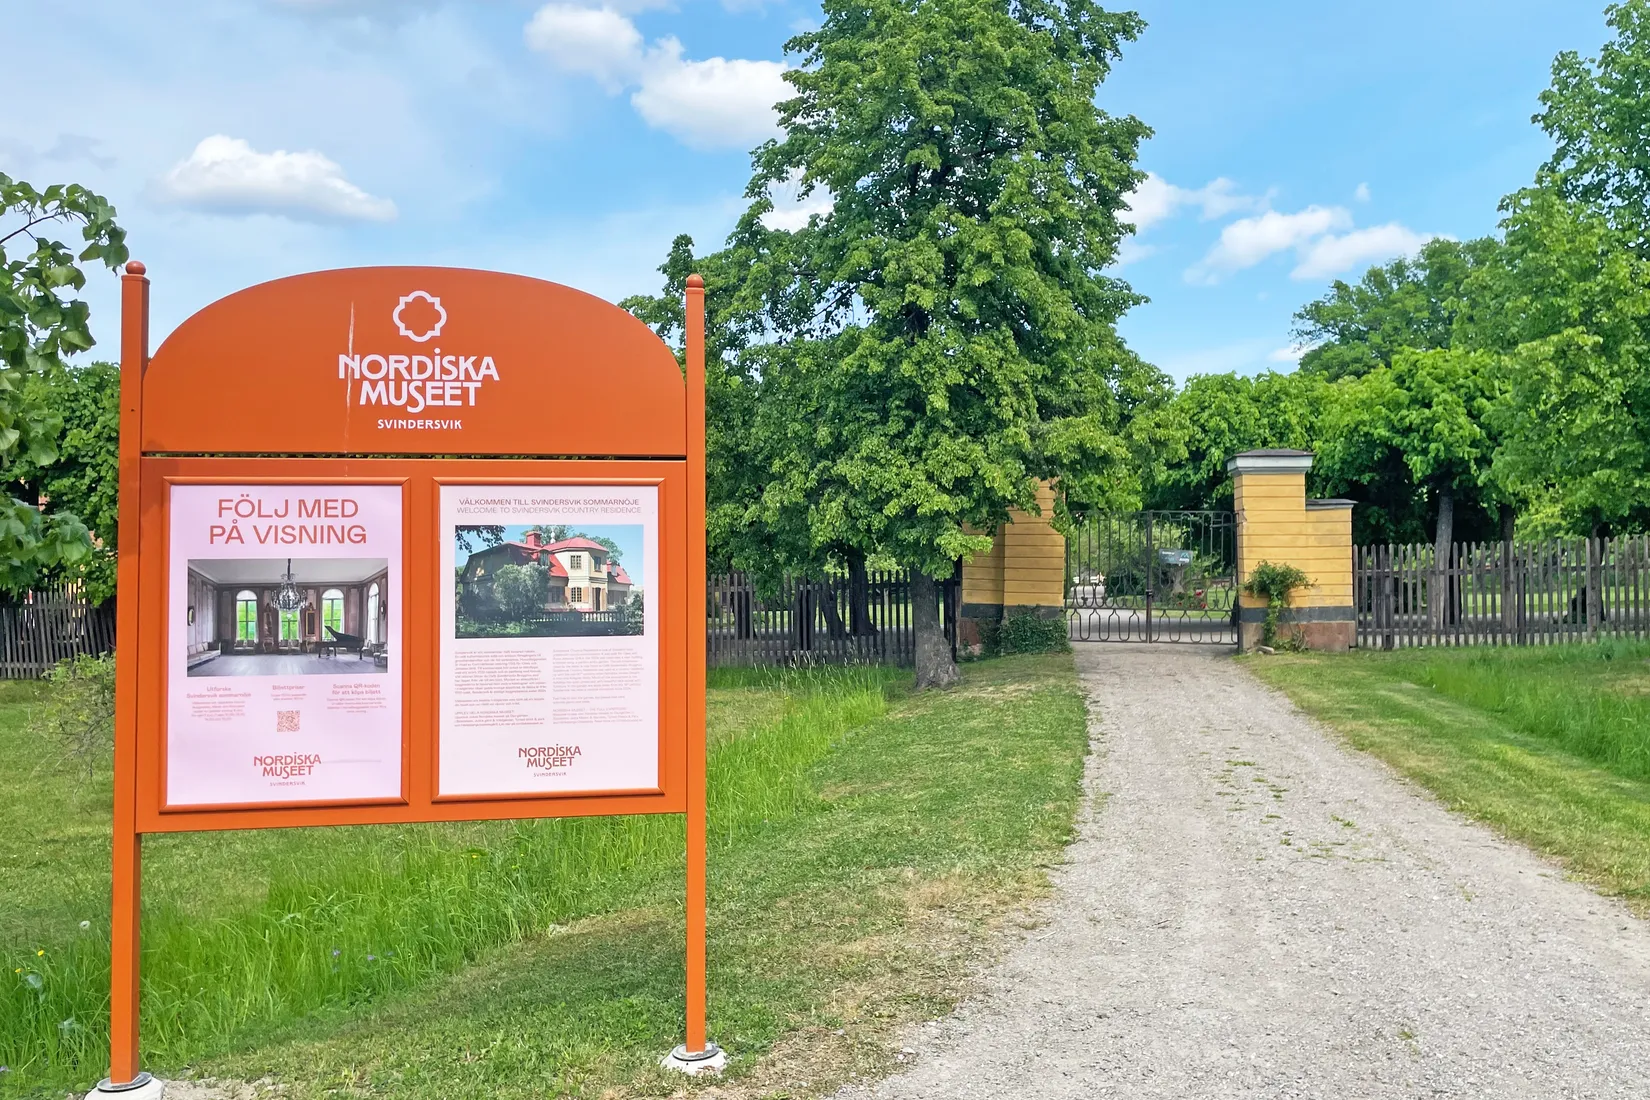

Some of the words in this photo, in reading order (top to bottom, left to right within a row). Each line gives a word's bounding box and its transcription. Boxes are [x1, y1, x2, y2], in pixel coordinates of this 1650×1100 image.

[338, 348, 500, 381] NORDISKA
[359, 380, 482, 413] MUSEET
[377, 419, 462, 430] SVINDERSVIK
[218, 493, 289, 518] FÖLJ
[298, 498, 359, 518] MED
[513, 498, 529, 506] TILL
[531, 498, 582, 506] SVINDERSVIK
[457, 506, 497, 514] WELCOME
[500, 506, 510, 514] TO
[512, 506, 561, 514] SVINDERSVIK
[561, 506, 600, 514] COUNTRY
[600, 506, 641, 514] RESIDENCE
[209, 519, 245, 545] PÅ
[252, 524, 367, 545] VISNING
[518, 743, 582, 758] NORDISKA
[254, 752, 322, 766] NORDISKA
[526, 756, 575, 770] MUSEET
[262, 765, 314, 779] MUSEET
